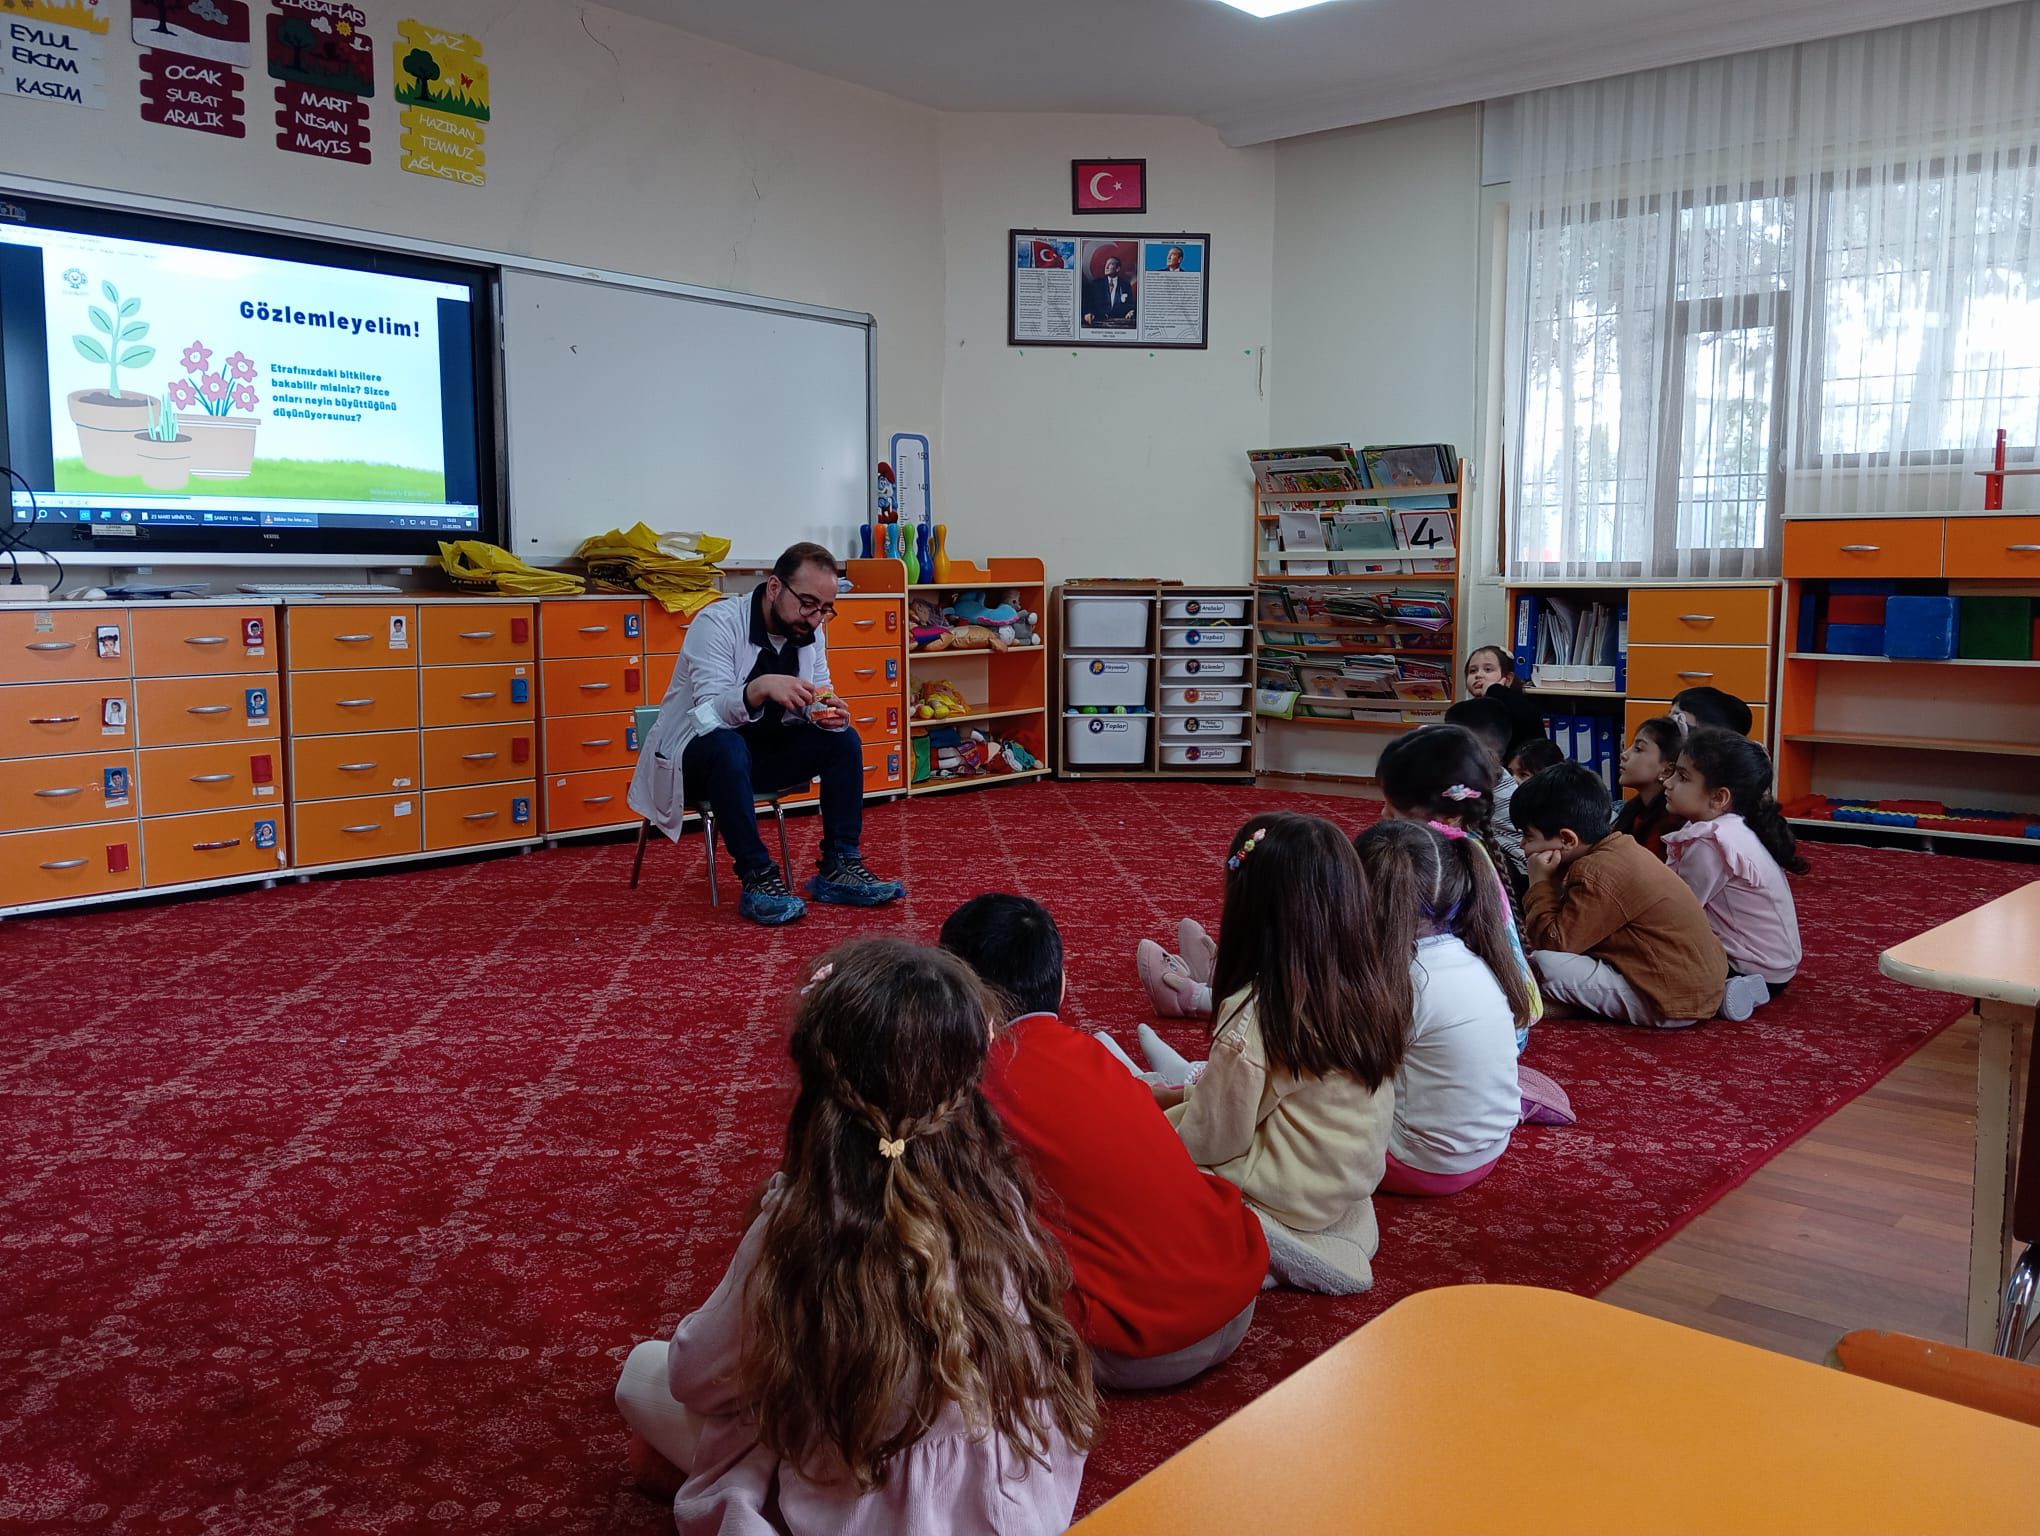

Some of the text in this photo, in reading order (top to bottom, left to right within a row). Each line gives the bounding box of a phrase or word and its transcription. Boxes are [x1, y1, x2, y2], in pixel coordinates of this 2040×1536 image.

[11, 23, 79, 51] EYLUL
[424, 31, 465, 52] YAZ
[164, 65, 223, 87] OCAK
[16, 77, 82, 104] KASIM
[165, 88, 223, 108] ŞUBAT
[301, 91, 352, 113] MART
[163, 109, 224, 127] ARALIK
[295, 111, 348, 135] NİSAN
[296, 133, 352, 154] MAYIS
[421, 135, 474, 161] TEMMUZ
[408, 155, 485, 186] AĞUSTOS
[240, 301, 420, 338] Gözlemleyelim!
[270, 364, 382, 382] Etrafınızdaki bitkilere
[271, 378, 390, 397] bakabilir misiniz? Sizce
[272, 394, 397, 412] onları neyin büyüttüğünü
[273, 408, 362, 422] düşünüyorsunuz?
[918, 452, 928, 460] 150
[918, 483, 928, 491] 140
[1411, 517, 1443, 549] 4
